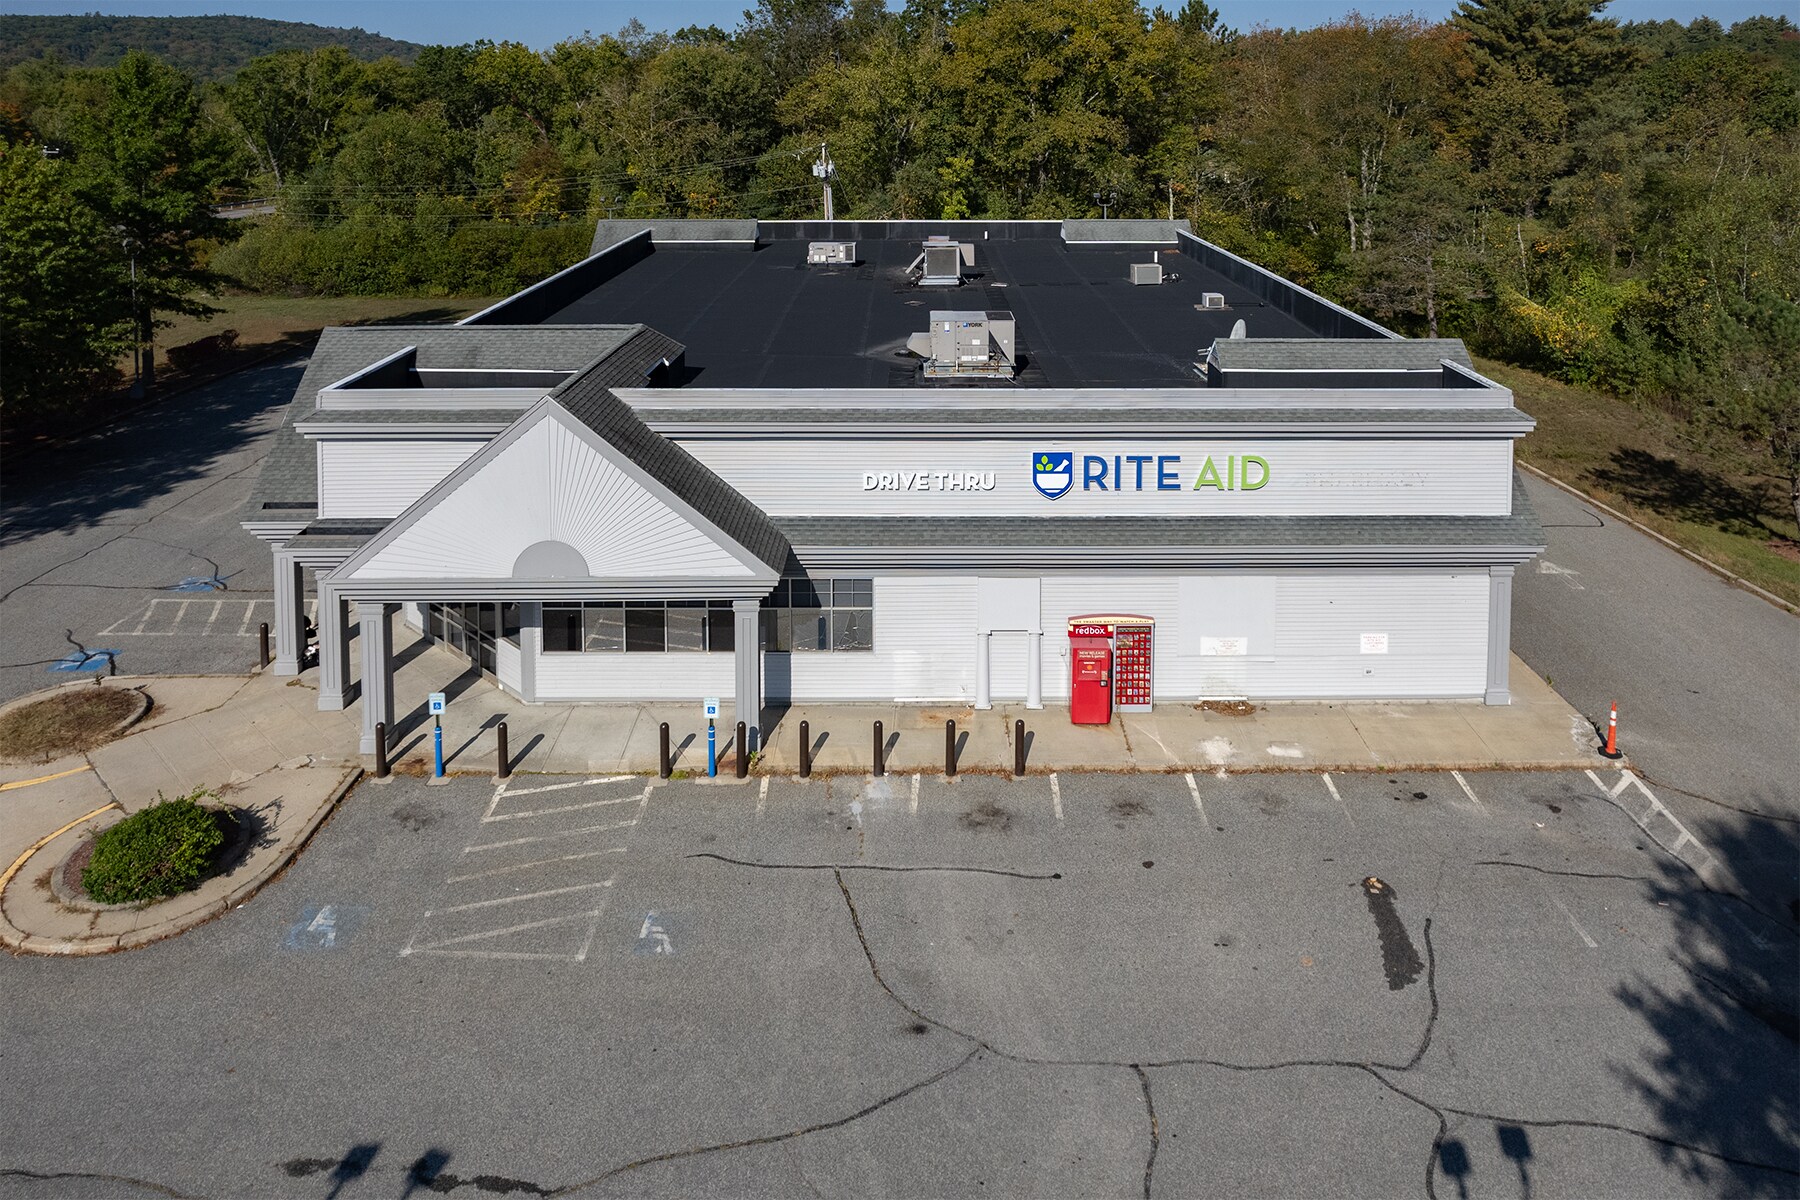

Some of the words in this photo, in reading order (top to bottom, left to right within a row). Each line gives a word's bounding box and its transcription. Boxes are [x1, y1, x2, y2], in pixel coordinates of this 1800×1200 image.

[862, 472, 931, 491] DRIVE
[934, 472, 997, 491] THRU
[1083, 455, 1181, 491] RITE
[1193, 455, 1271, 491] AID
[1075, 627, 1105, 635] redbox
